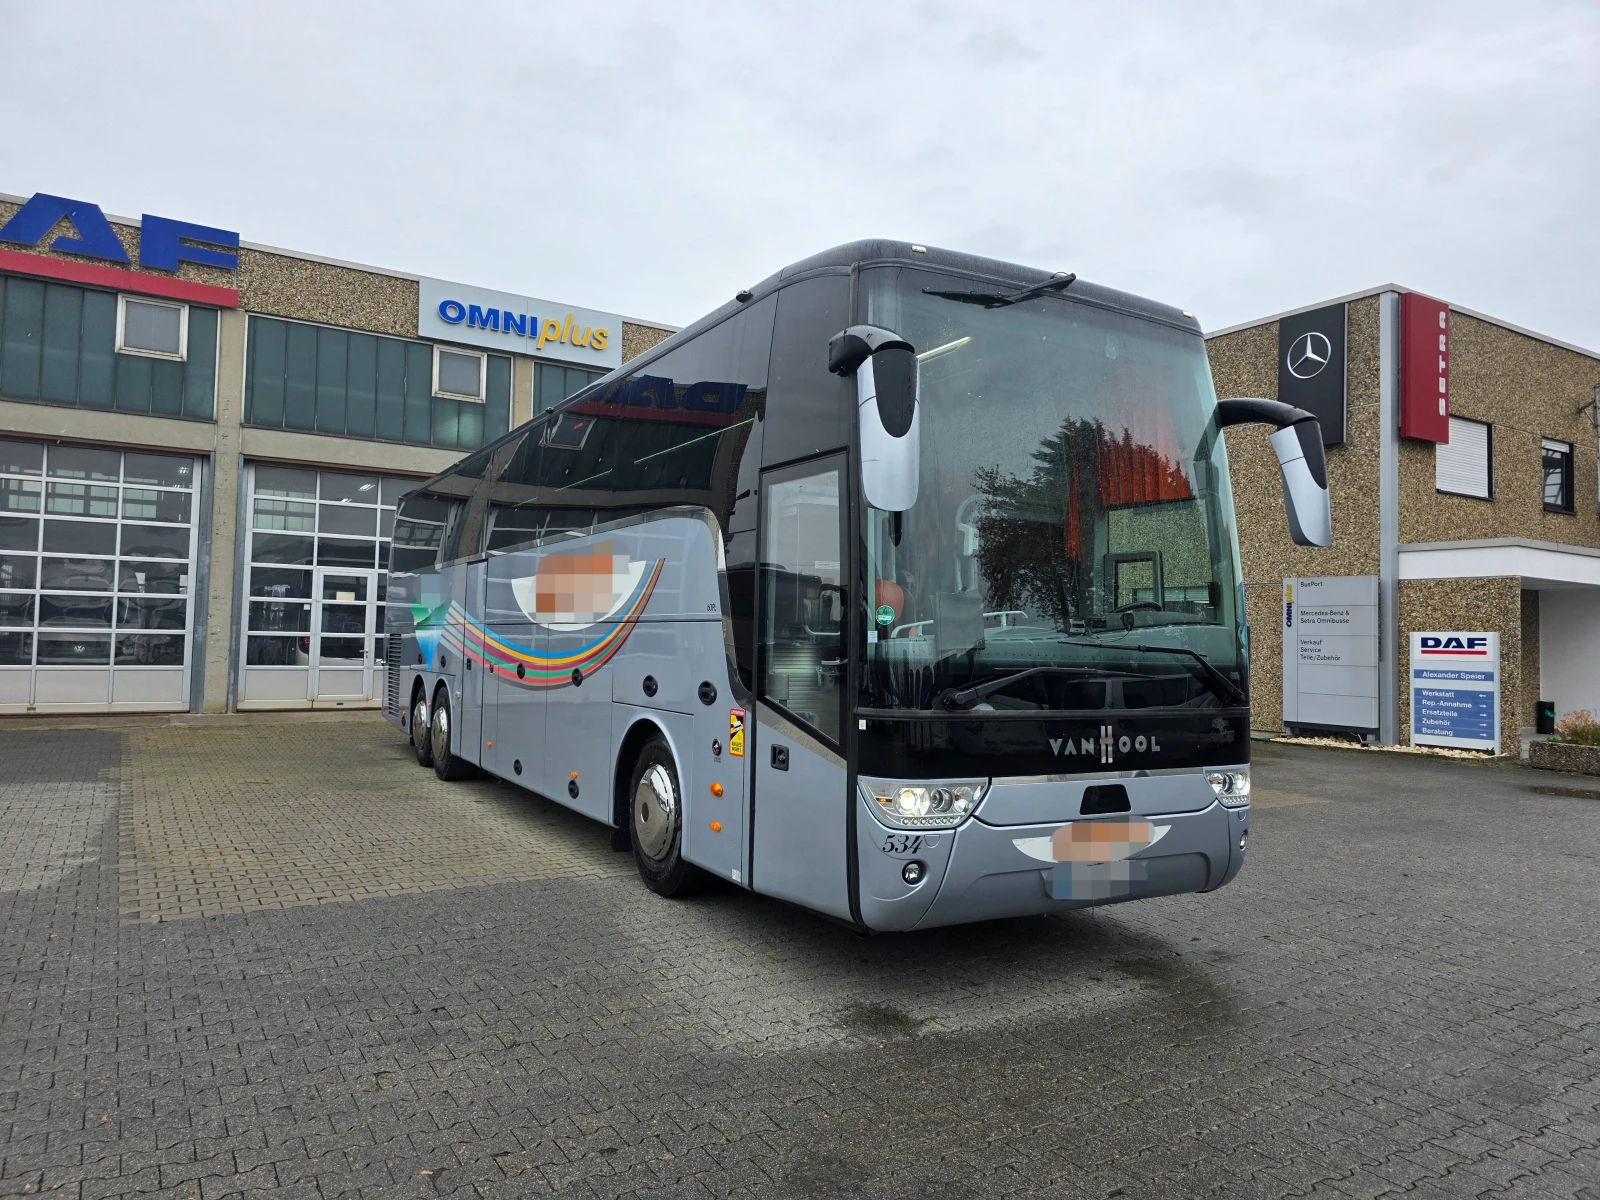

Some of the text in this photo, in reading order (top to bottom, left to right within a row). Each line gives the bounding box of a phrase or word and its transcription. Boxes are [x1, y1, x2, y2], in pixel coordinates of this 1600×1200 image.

[438, 299, 609, 350] OMNIplus
[1285, 583, 1294, 628] OMNIplus
[1421, 637, 1487, 649] DAF
[1422, 671, 1485, 680] Alexander Speier
[1422, 690, 1455, 698] Werkstatt
[1422, 699, 1473, 709] Rep.-Annahme
[1422, 709, 1458, 717] Ersatzteile
[1422, 718, 1451, 726] Zubehör
[1422, 727, 1454, 737] Beratung
[882, 834, 923, 854] 534
